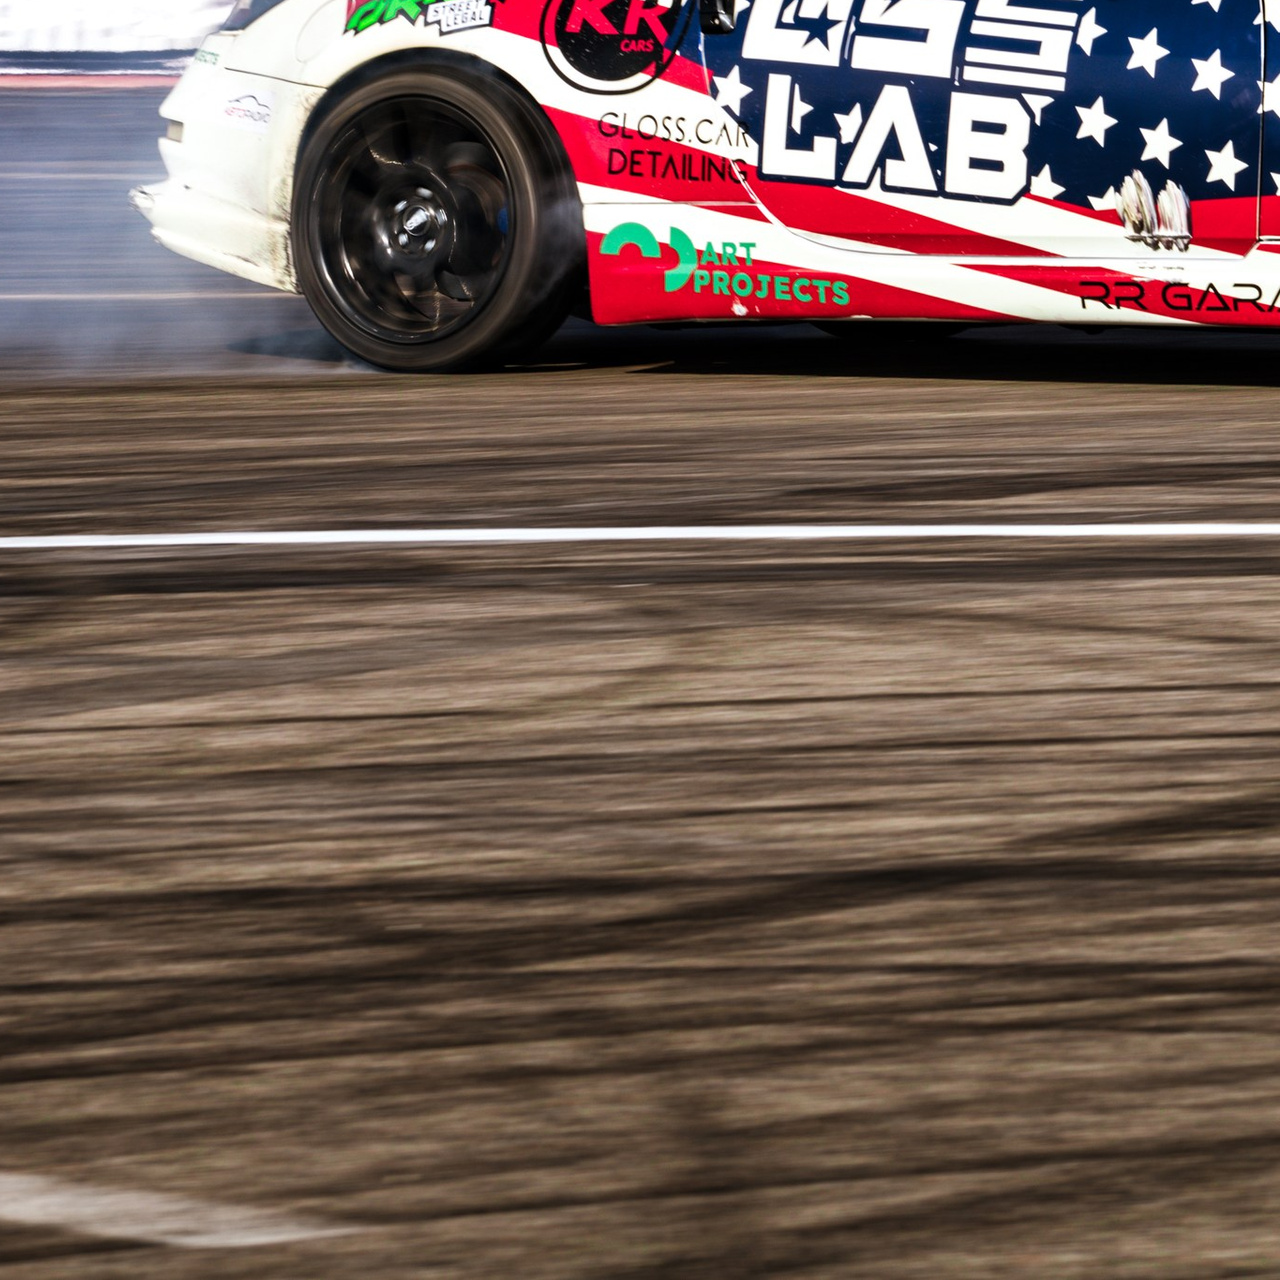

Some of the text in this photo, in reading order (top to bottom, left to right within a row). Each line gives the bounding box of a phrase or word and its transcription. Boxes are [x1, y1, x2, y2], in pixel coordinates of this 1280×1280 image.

[445, 12, 485, 28] LEGAL
[619, 38, 655, 53] CARS
[761, 72, 1032, 200] LAB
[607, 147, 748, 185] DETAILING
[700, 240, 757, 267] ART
[693, 269, 851, 306] PROJECTS
[1079, 281, 1149, 310] RR
